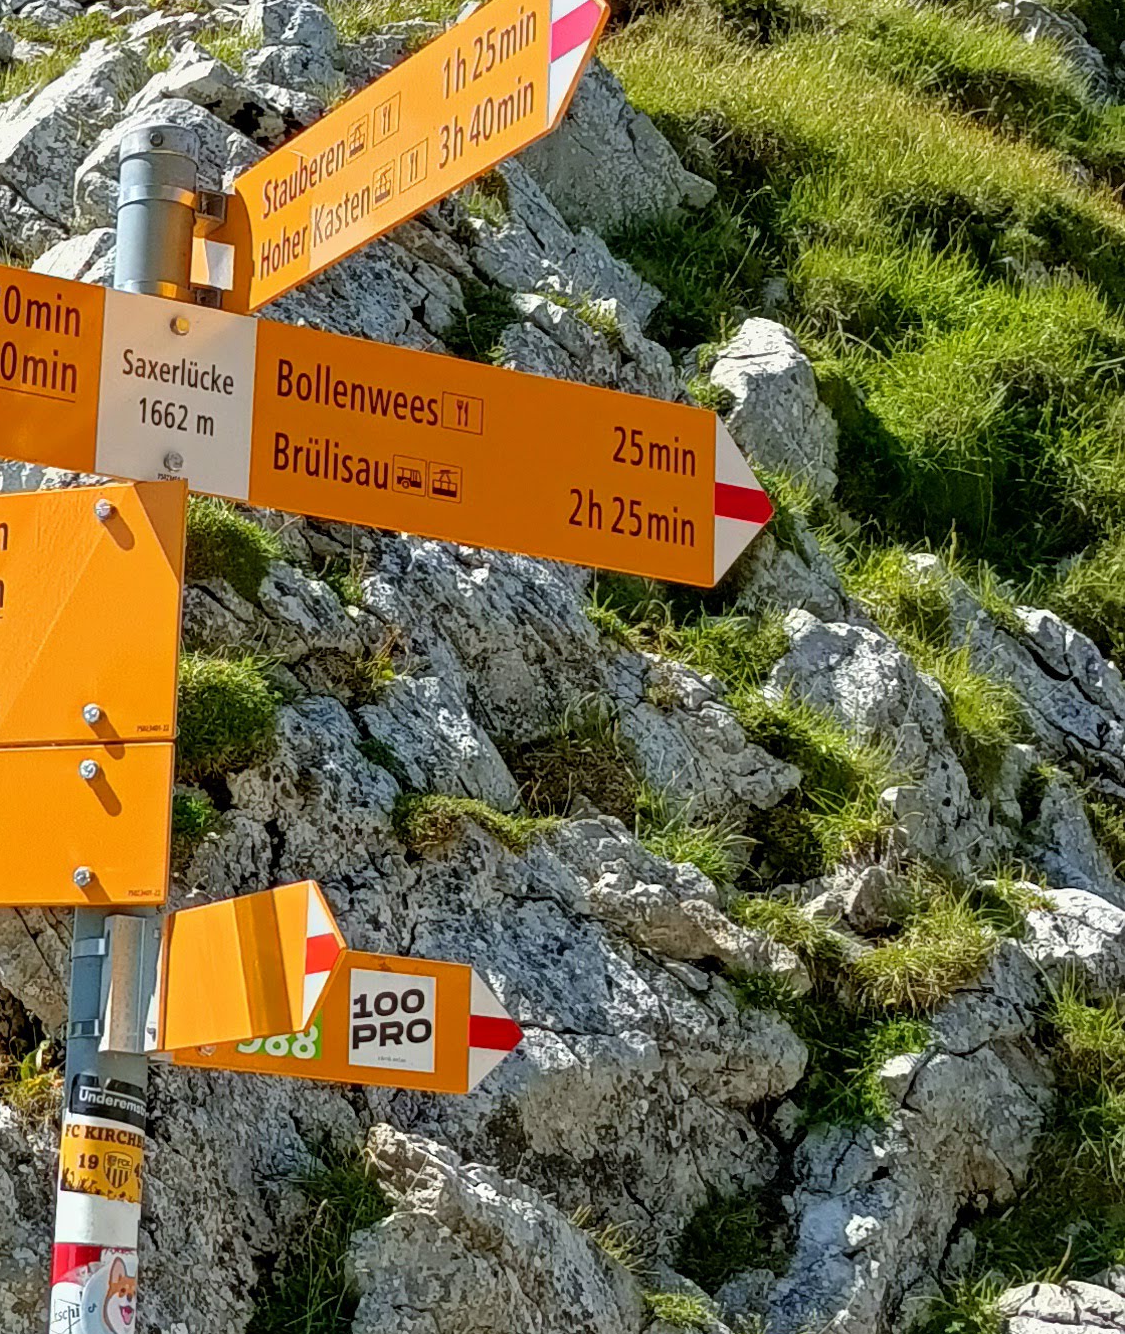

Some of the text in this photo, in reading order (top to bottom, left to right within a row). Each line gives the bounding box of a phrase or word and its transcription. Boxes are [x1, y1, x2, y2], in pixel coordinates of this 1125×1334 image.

[442, 7, 537, 100] 1h 25min
[439, 79, 535, 169] 3h 40min
[262, 139, 347, 219] Stauberen
[260, 186, 372, 282] Hoher Kasten
[122, 349, 235, 396] Saxerlücke
[276, 358, 439, 428] Bollenwees
[138, 397, 215, 437] 1662 m
[274, 431, 389, 491] Brülisau
[612, 426, 697, 477] 25min
[568, 489, 696, 548] 2h 25min
[353, 988, 425, 1019] 100
[352, 1018, 432, 1050] PRO
